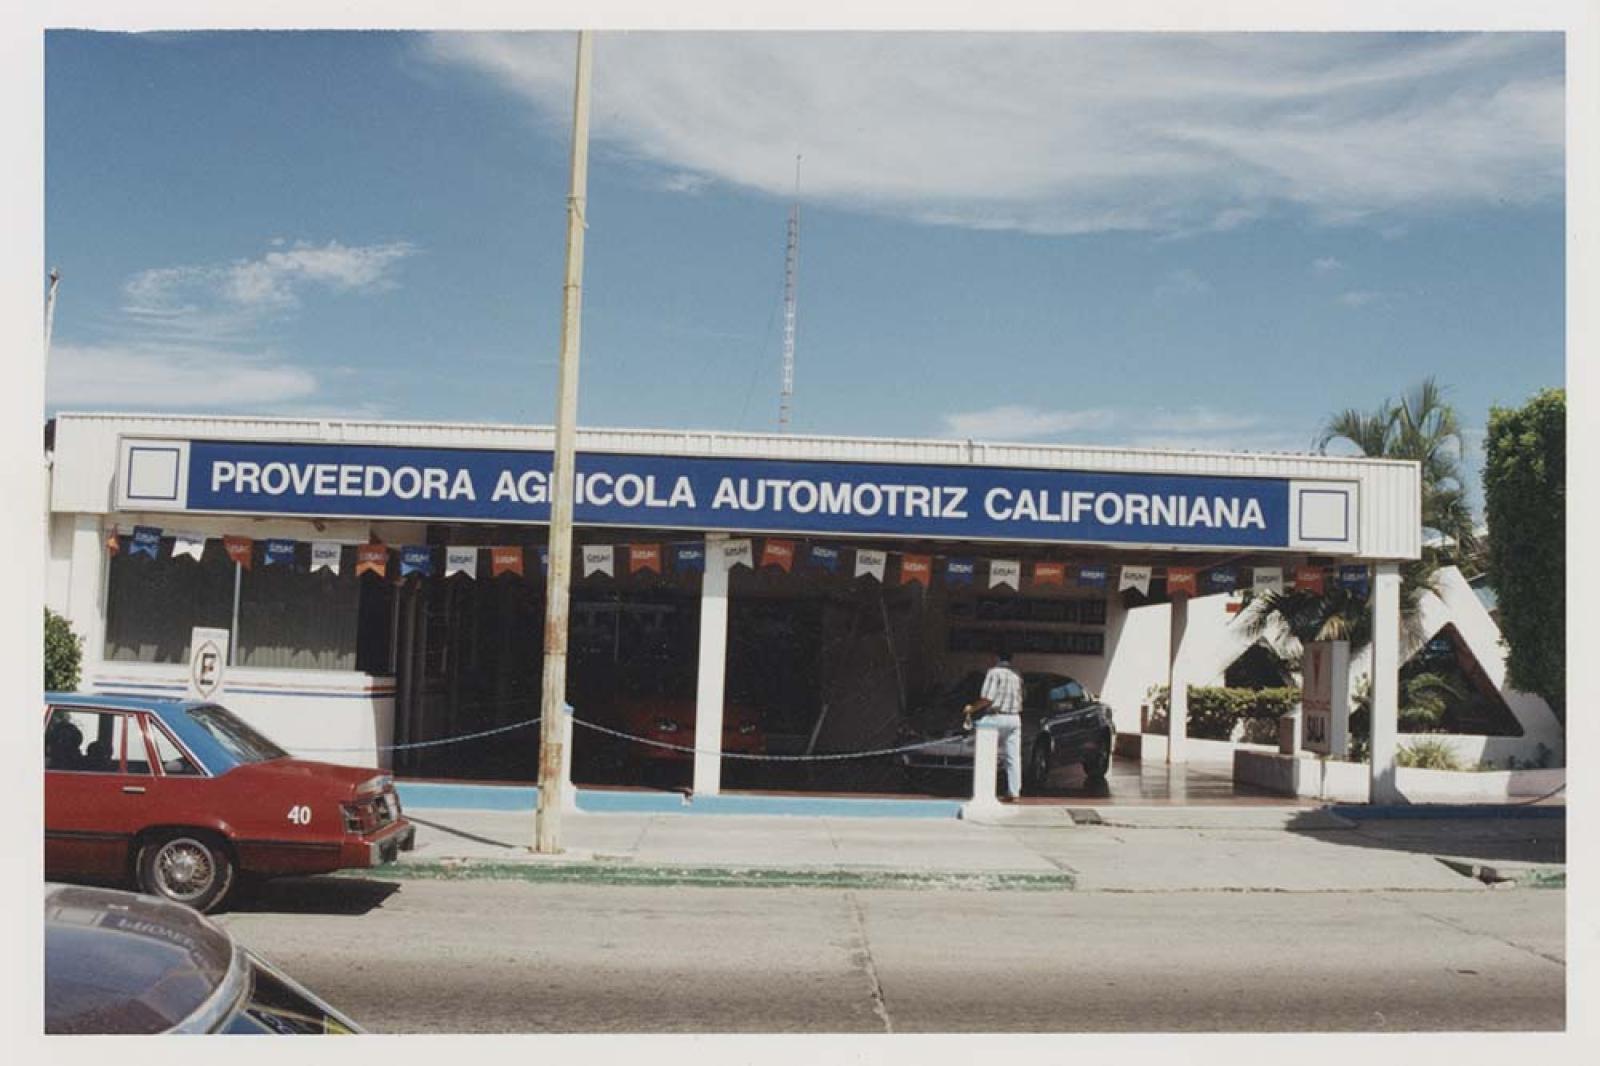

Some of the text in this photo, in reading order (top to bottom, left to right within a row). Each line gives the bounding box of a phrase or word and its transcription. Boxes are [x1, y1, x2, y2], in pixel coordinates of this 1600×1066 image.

[211, 461, 1267, 529] PROVEEDORA AGICOLA AUTOMOTRIZ CALIFORNIANA
[200, 653, 216, 685] E
[287, 805, 312, 825] 40
